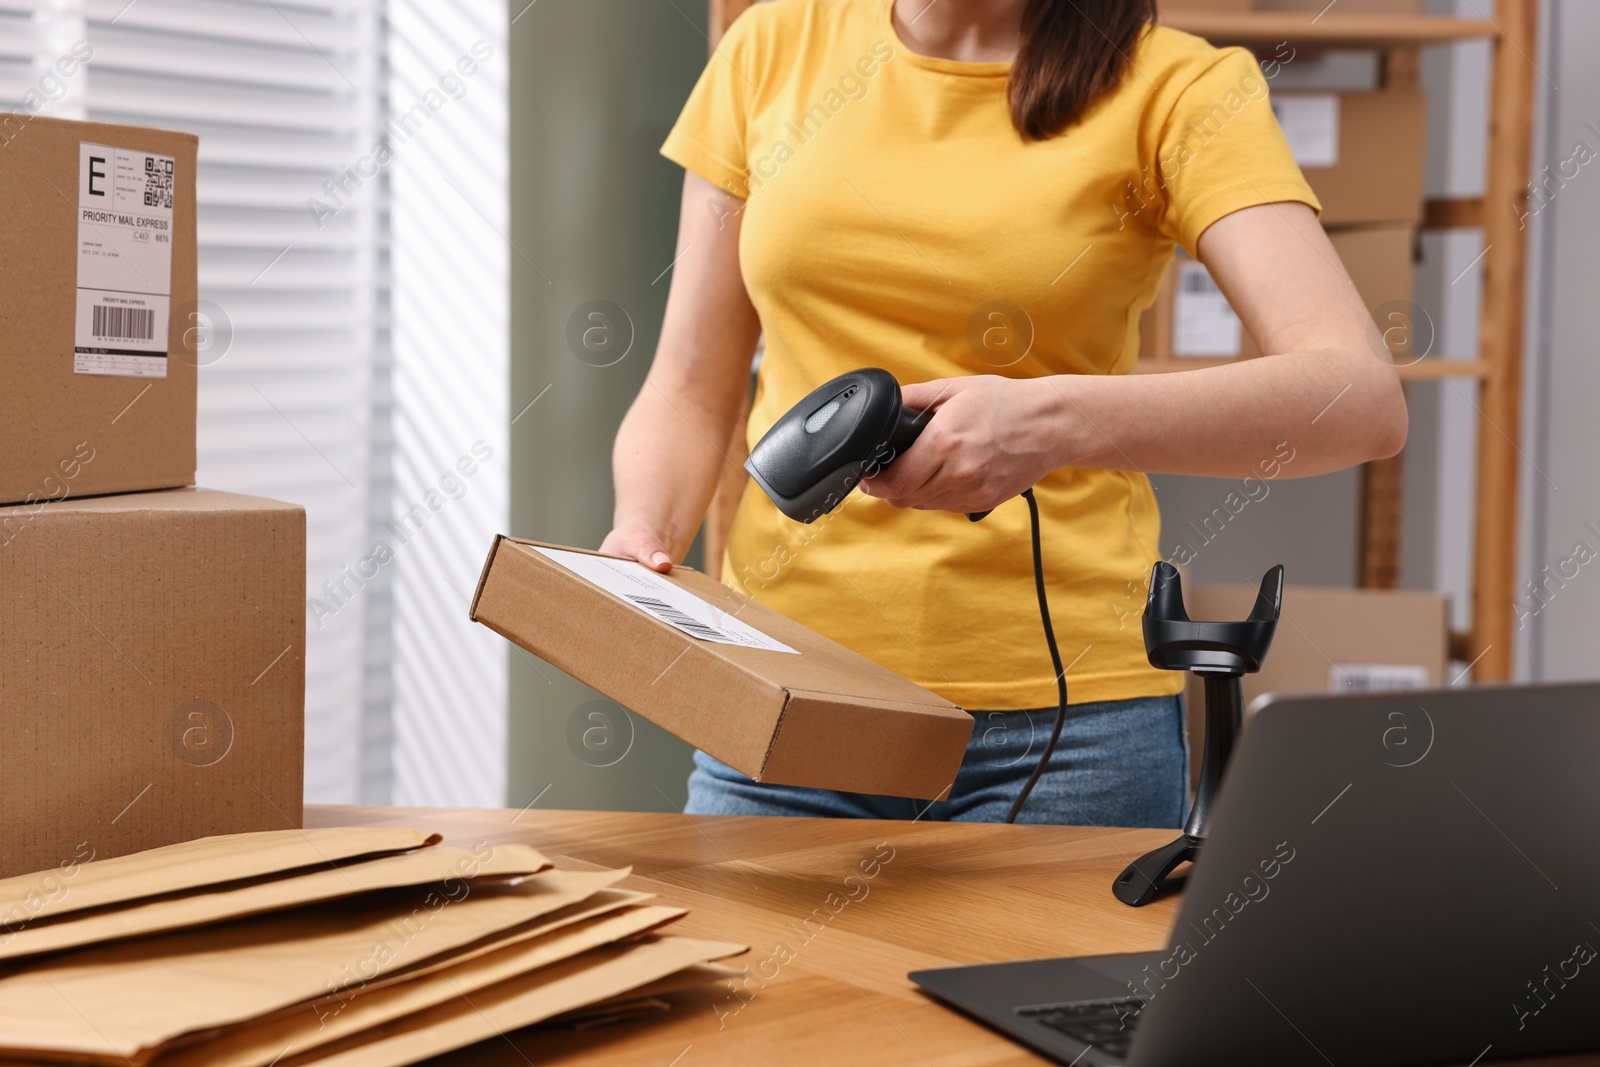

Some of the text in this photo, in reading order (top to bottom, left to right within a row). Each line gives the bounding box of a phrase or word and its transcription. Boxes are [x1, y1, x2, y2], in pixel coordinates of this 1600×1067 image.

[88, 156, 106, 197] E
[82, 210, 168, 230] PRIORITY MAIL EXPRESS
